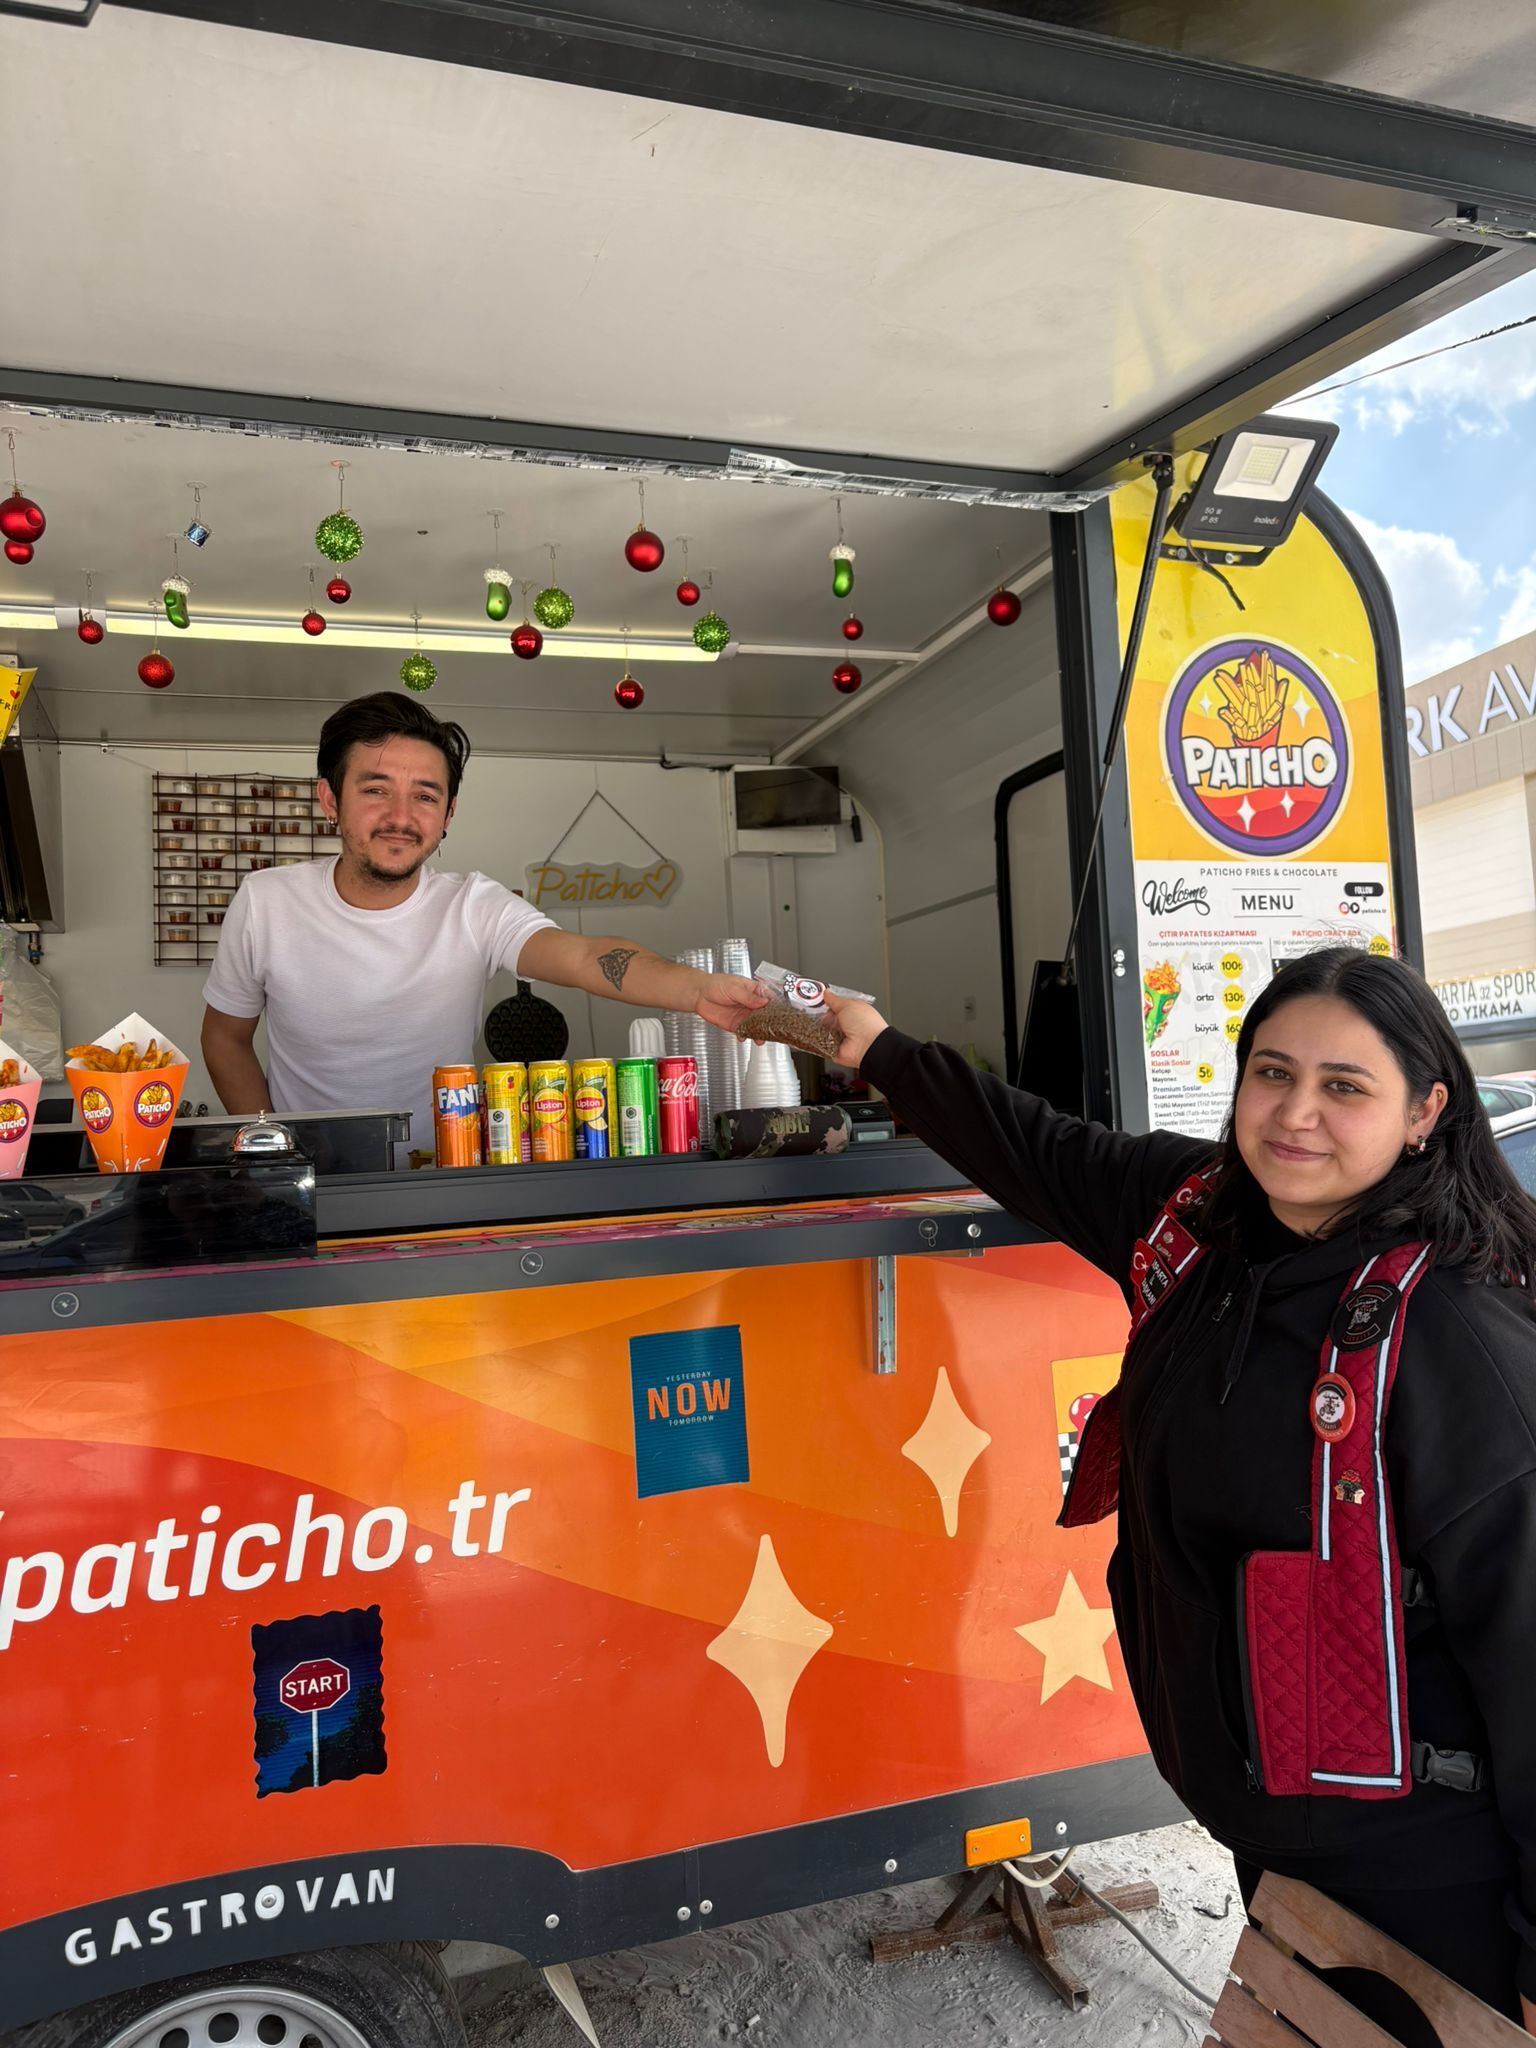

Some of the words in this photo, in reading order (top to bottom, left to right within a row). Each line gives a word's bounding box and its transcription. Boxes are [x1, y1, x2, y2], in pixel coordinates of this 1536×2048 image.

[1182, 736, 1339, 789] PATICHO
[1200, 868, 1242, 877] PATICHO
[1245, 868, 1271, 877] FRIES
[1273, 868, 1280, 877] &
[1282, 868, 1338, 877] CHOCOLATE
[1142, 877, 1211, 916] Welcome
[1241, 895, 1294, 911] MENU
[1159, 930, 1178, 939] ÇITIR
[1180, 930, 1212, 938] PATATES
[1213, 930, 1258, 938] KIZARTMASI
[1292, 930, 1322, 938] PATICHO
[1192, 963, 1215, 973] küçük
[1480, 986, 1490, 1000] 32
[1493, 971, 1536, 999] SPOR
[1196, 993, 1215, 1001] orta
[1463, 1000, 1523, 1020] YIKAMA
[1194, 1024, 1219, 1034] büyük
[138, 1101, 171, 1114] PATICHO
[536, 1101, 562, 1111] Lipton
[577, 1100, 600, 1109] Lipton
[83, 1106, 111, 1120] PATICHO
[769, 1112, 810, 1136] JBL
[666, 1371, 711, 1383] YESTERDAY
[647, 1378, 731, 1420] NOW
[668, 1415, 715, 1427] TOMORROW
[285, 1673, 344, 1699] START
[64, 1867, 396, 1967] GASTROVAN
